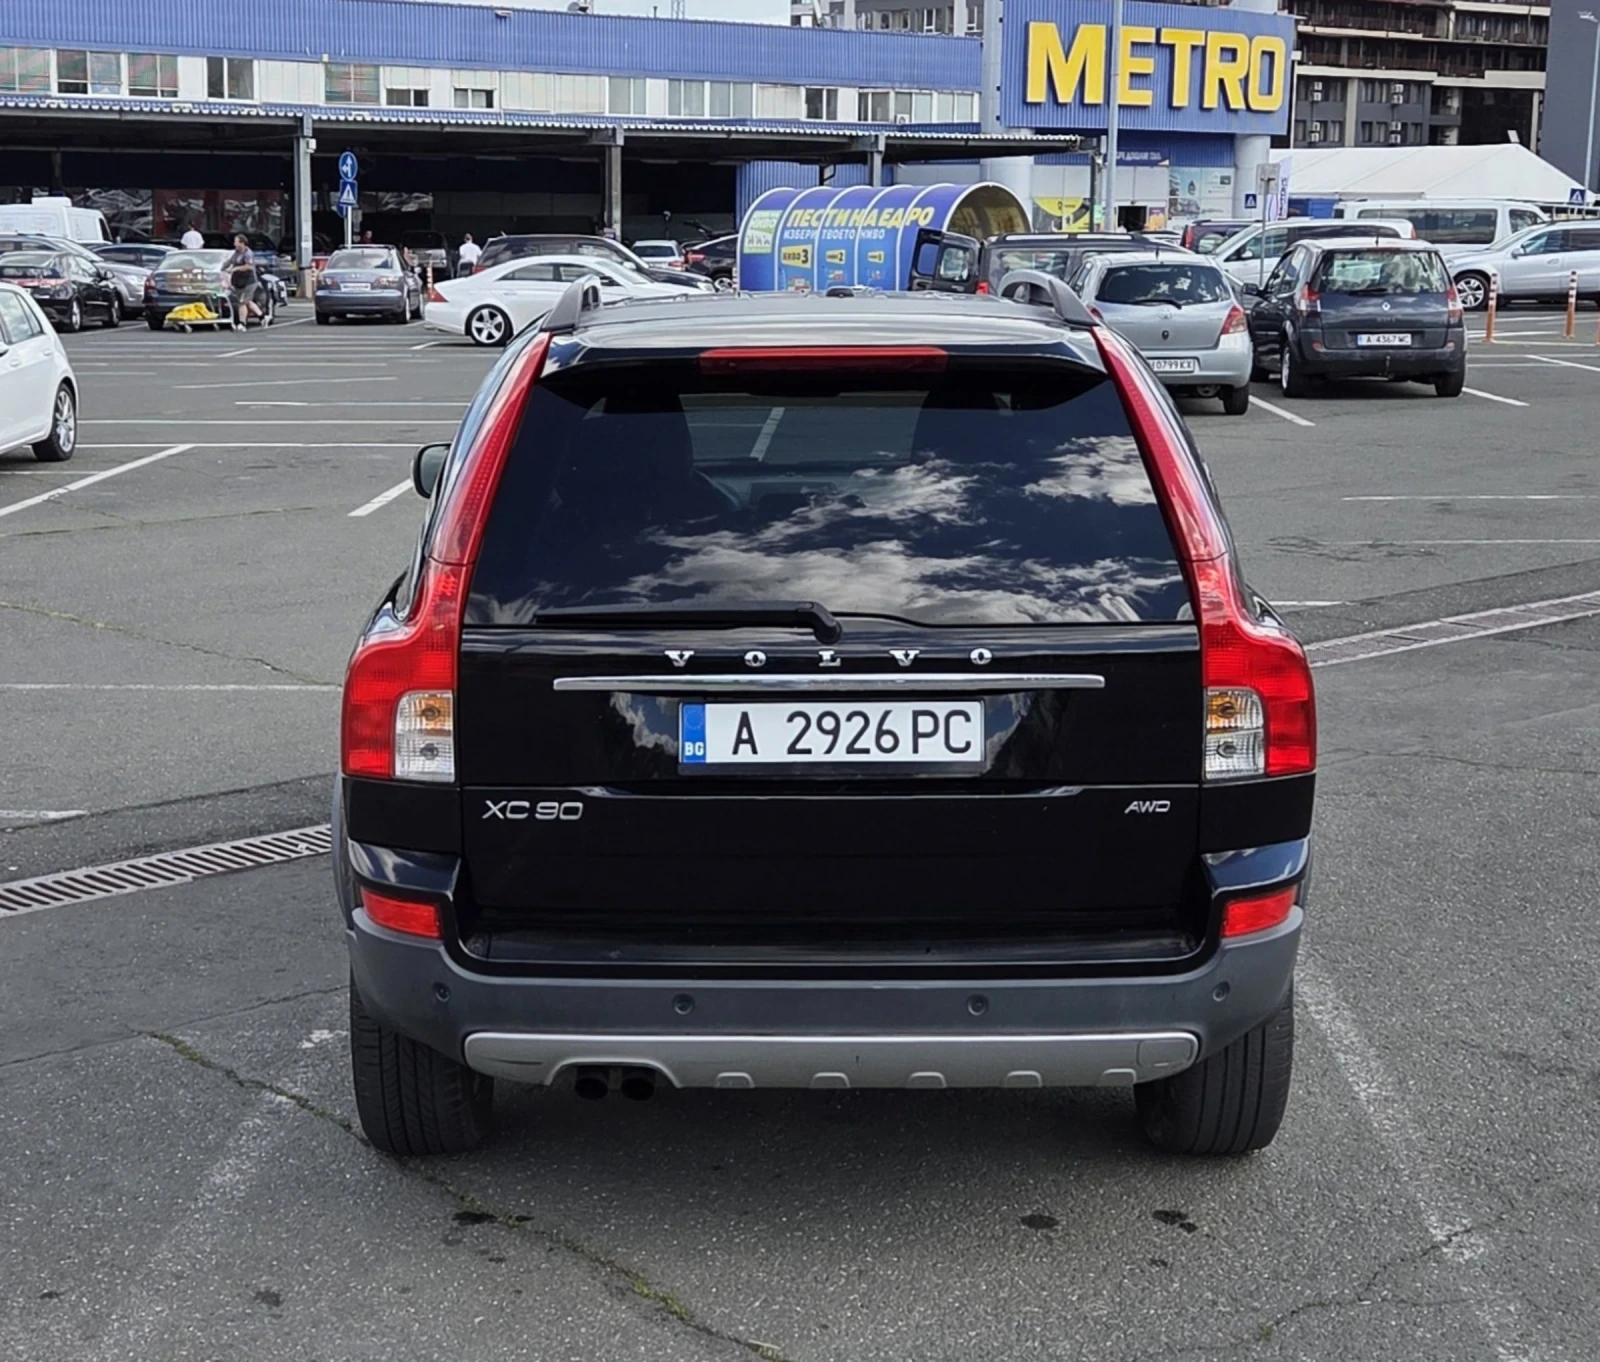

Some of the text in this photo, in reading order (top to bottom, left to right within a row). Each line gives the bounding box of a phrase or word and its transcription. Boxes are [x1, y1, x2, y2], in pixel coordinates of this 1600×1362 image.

[1026, 21, 1286, 111] METRO
[786, 208, 849, 227] ПЕСТИ
[849, 207, 876, 227] НА
[877, 206, 935, 228] ЕДРО
[783, 229, 817, 240] ИЗБЕРИ
[821, 228, 855, 240] ТВОЕТО
[801, 248, 809, 264] 3
[664, 647, 993, 668] VOLVO
[731, 709, 972, 755] A 2926 PC
[684, 741, 705, 756] BG
[1124, 800, 1171, 814] AWD
